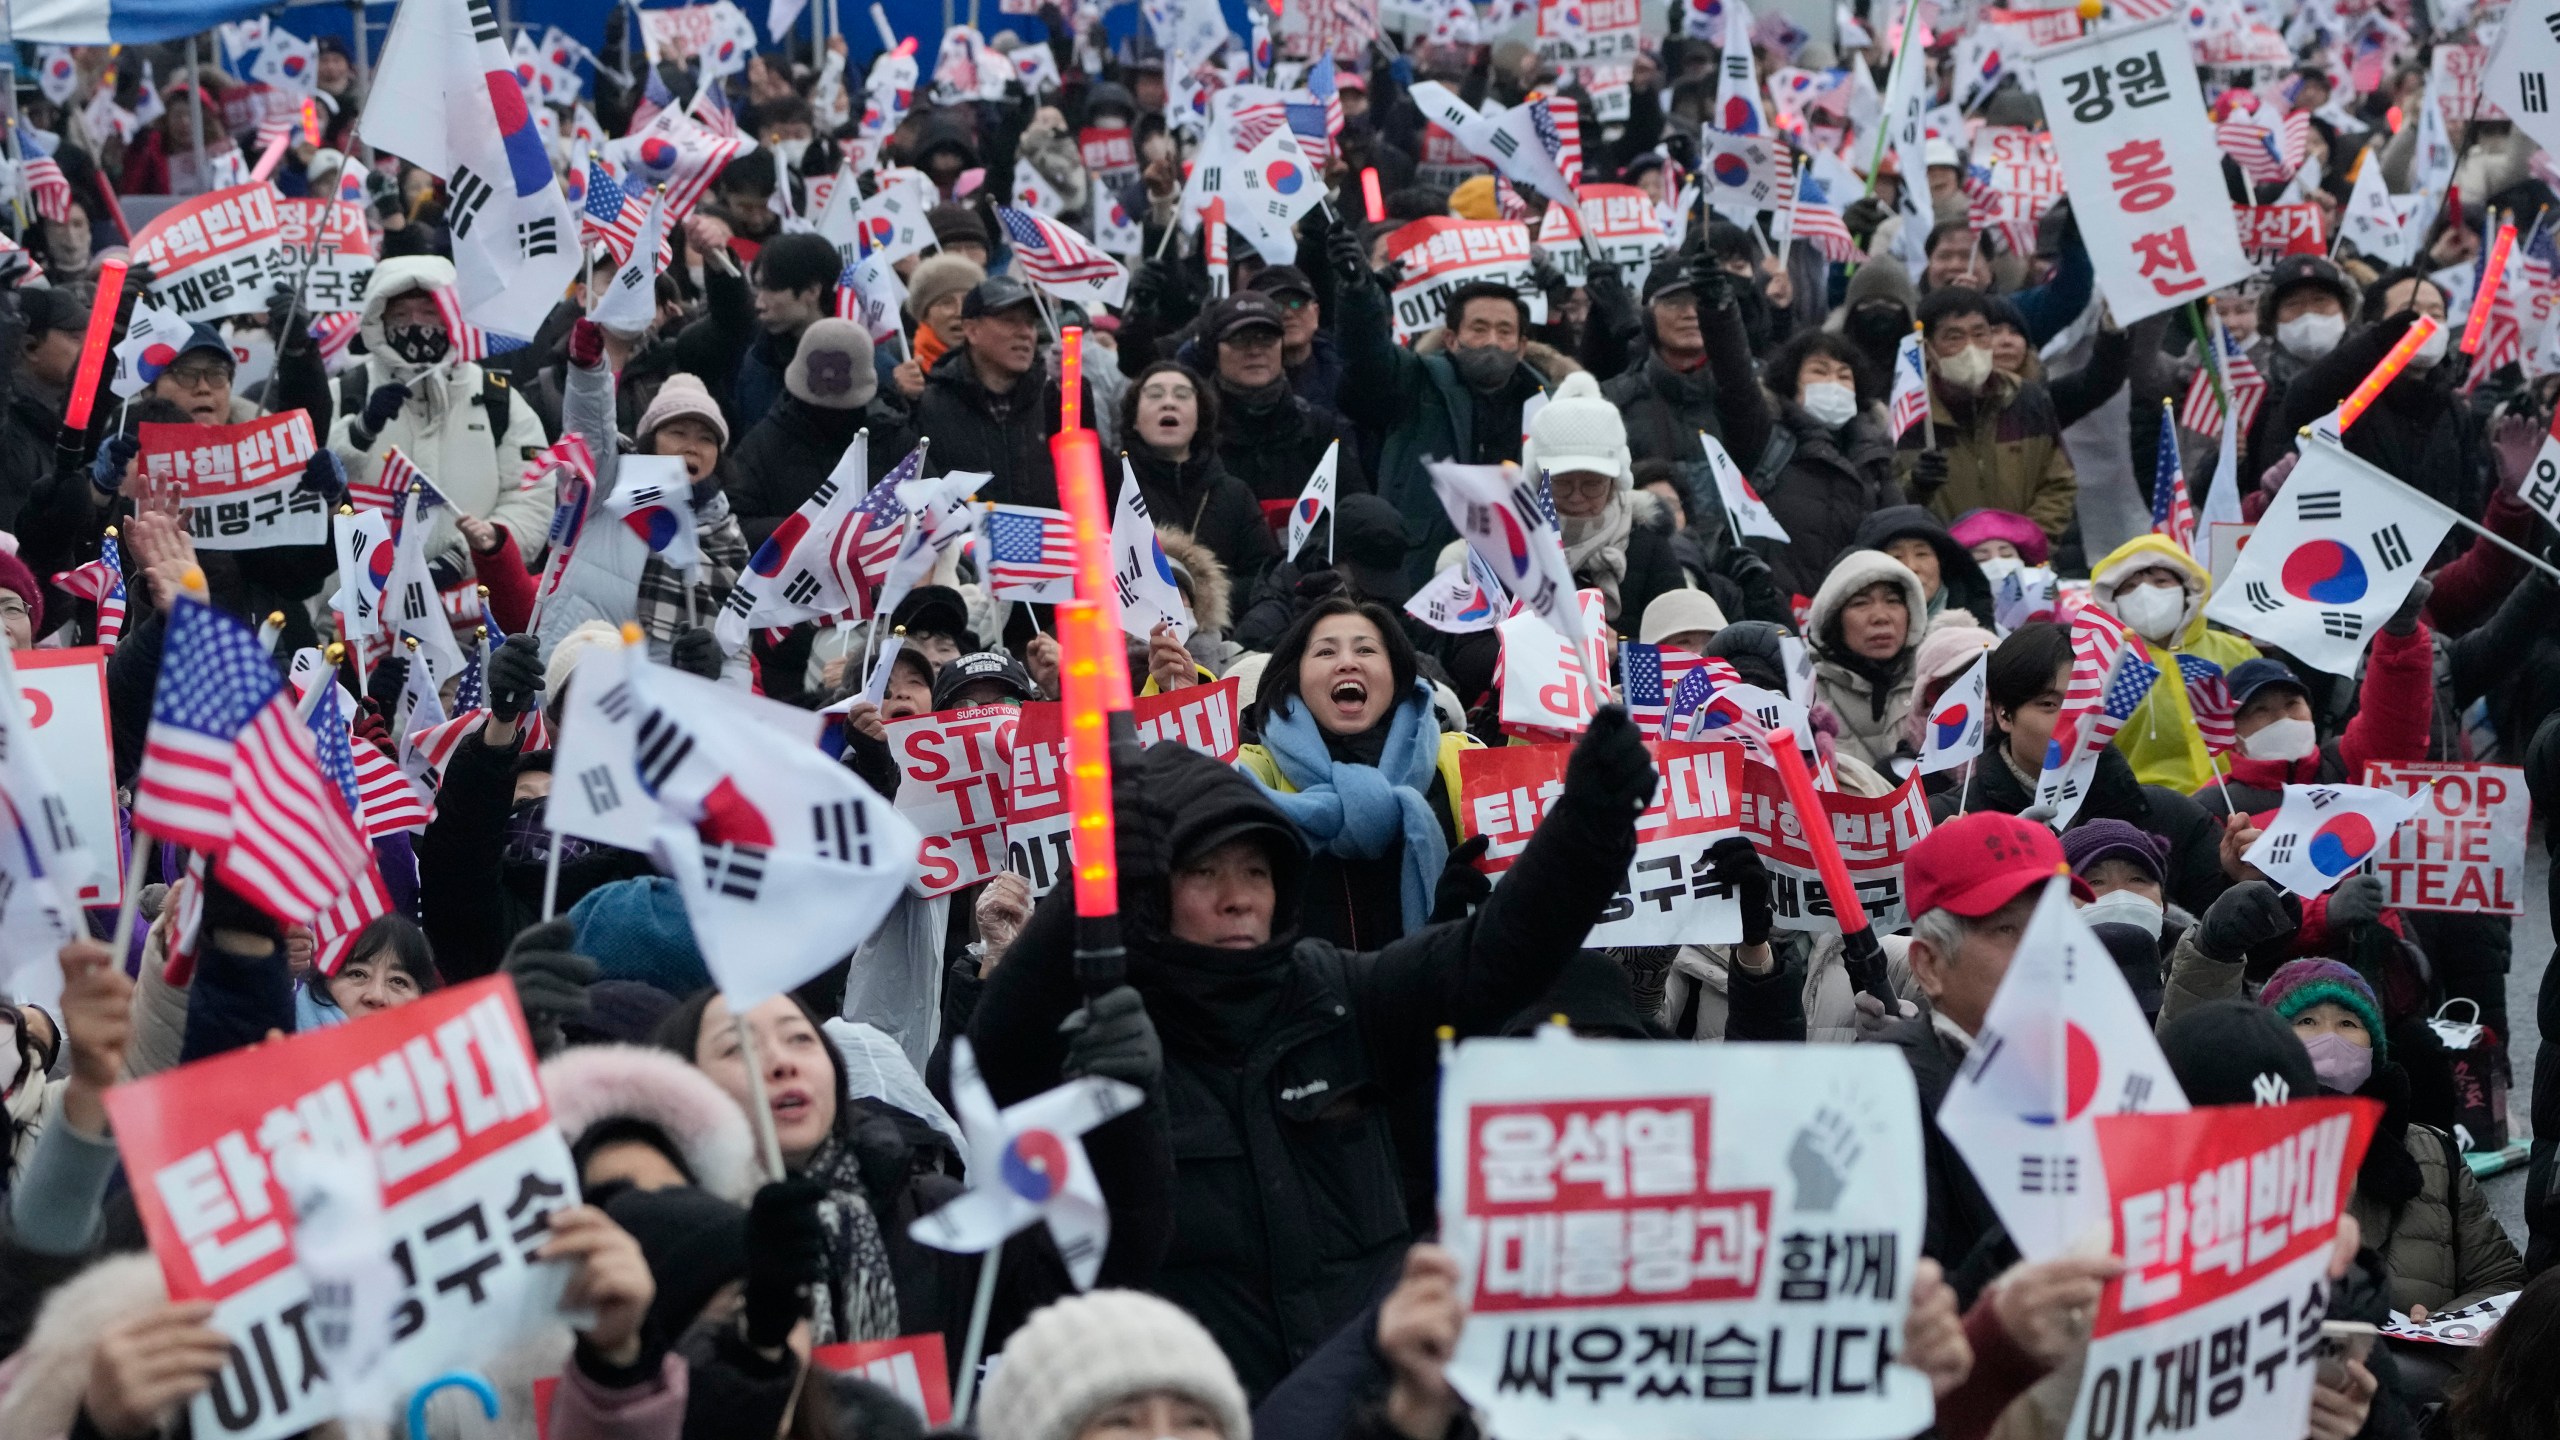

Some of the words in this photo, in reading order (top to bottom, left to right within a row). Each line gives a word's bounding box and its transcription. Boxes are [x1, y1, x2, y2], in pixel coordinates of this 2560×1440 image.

[2061, 50, 2171, 123] 강원
[2106, 139, 2207, 297] 홍천
[146, 415, 316, 492] 탄핵반대
[957, 706, 1000, 720] SUPPORT
[1480, 1107, 1698, 1203] 윤석열
[1486, 1203, 1764, 1298] 대통령과
[1778, 1232, 1897, 1304] 함께
[2121, 1111, 2353, 1314] 탄핵반대
[1499, 1324, 1894, 1403] 싸우겠습니다
